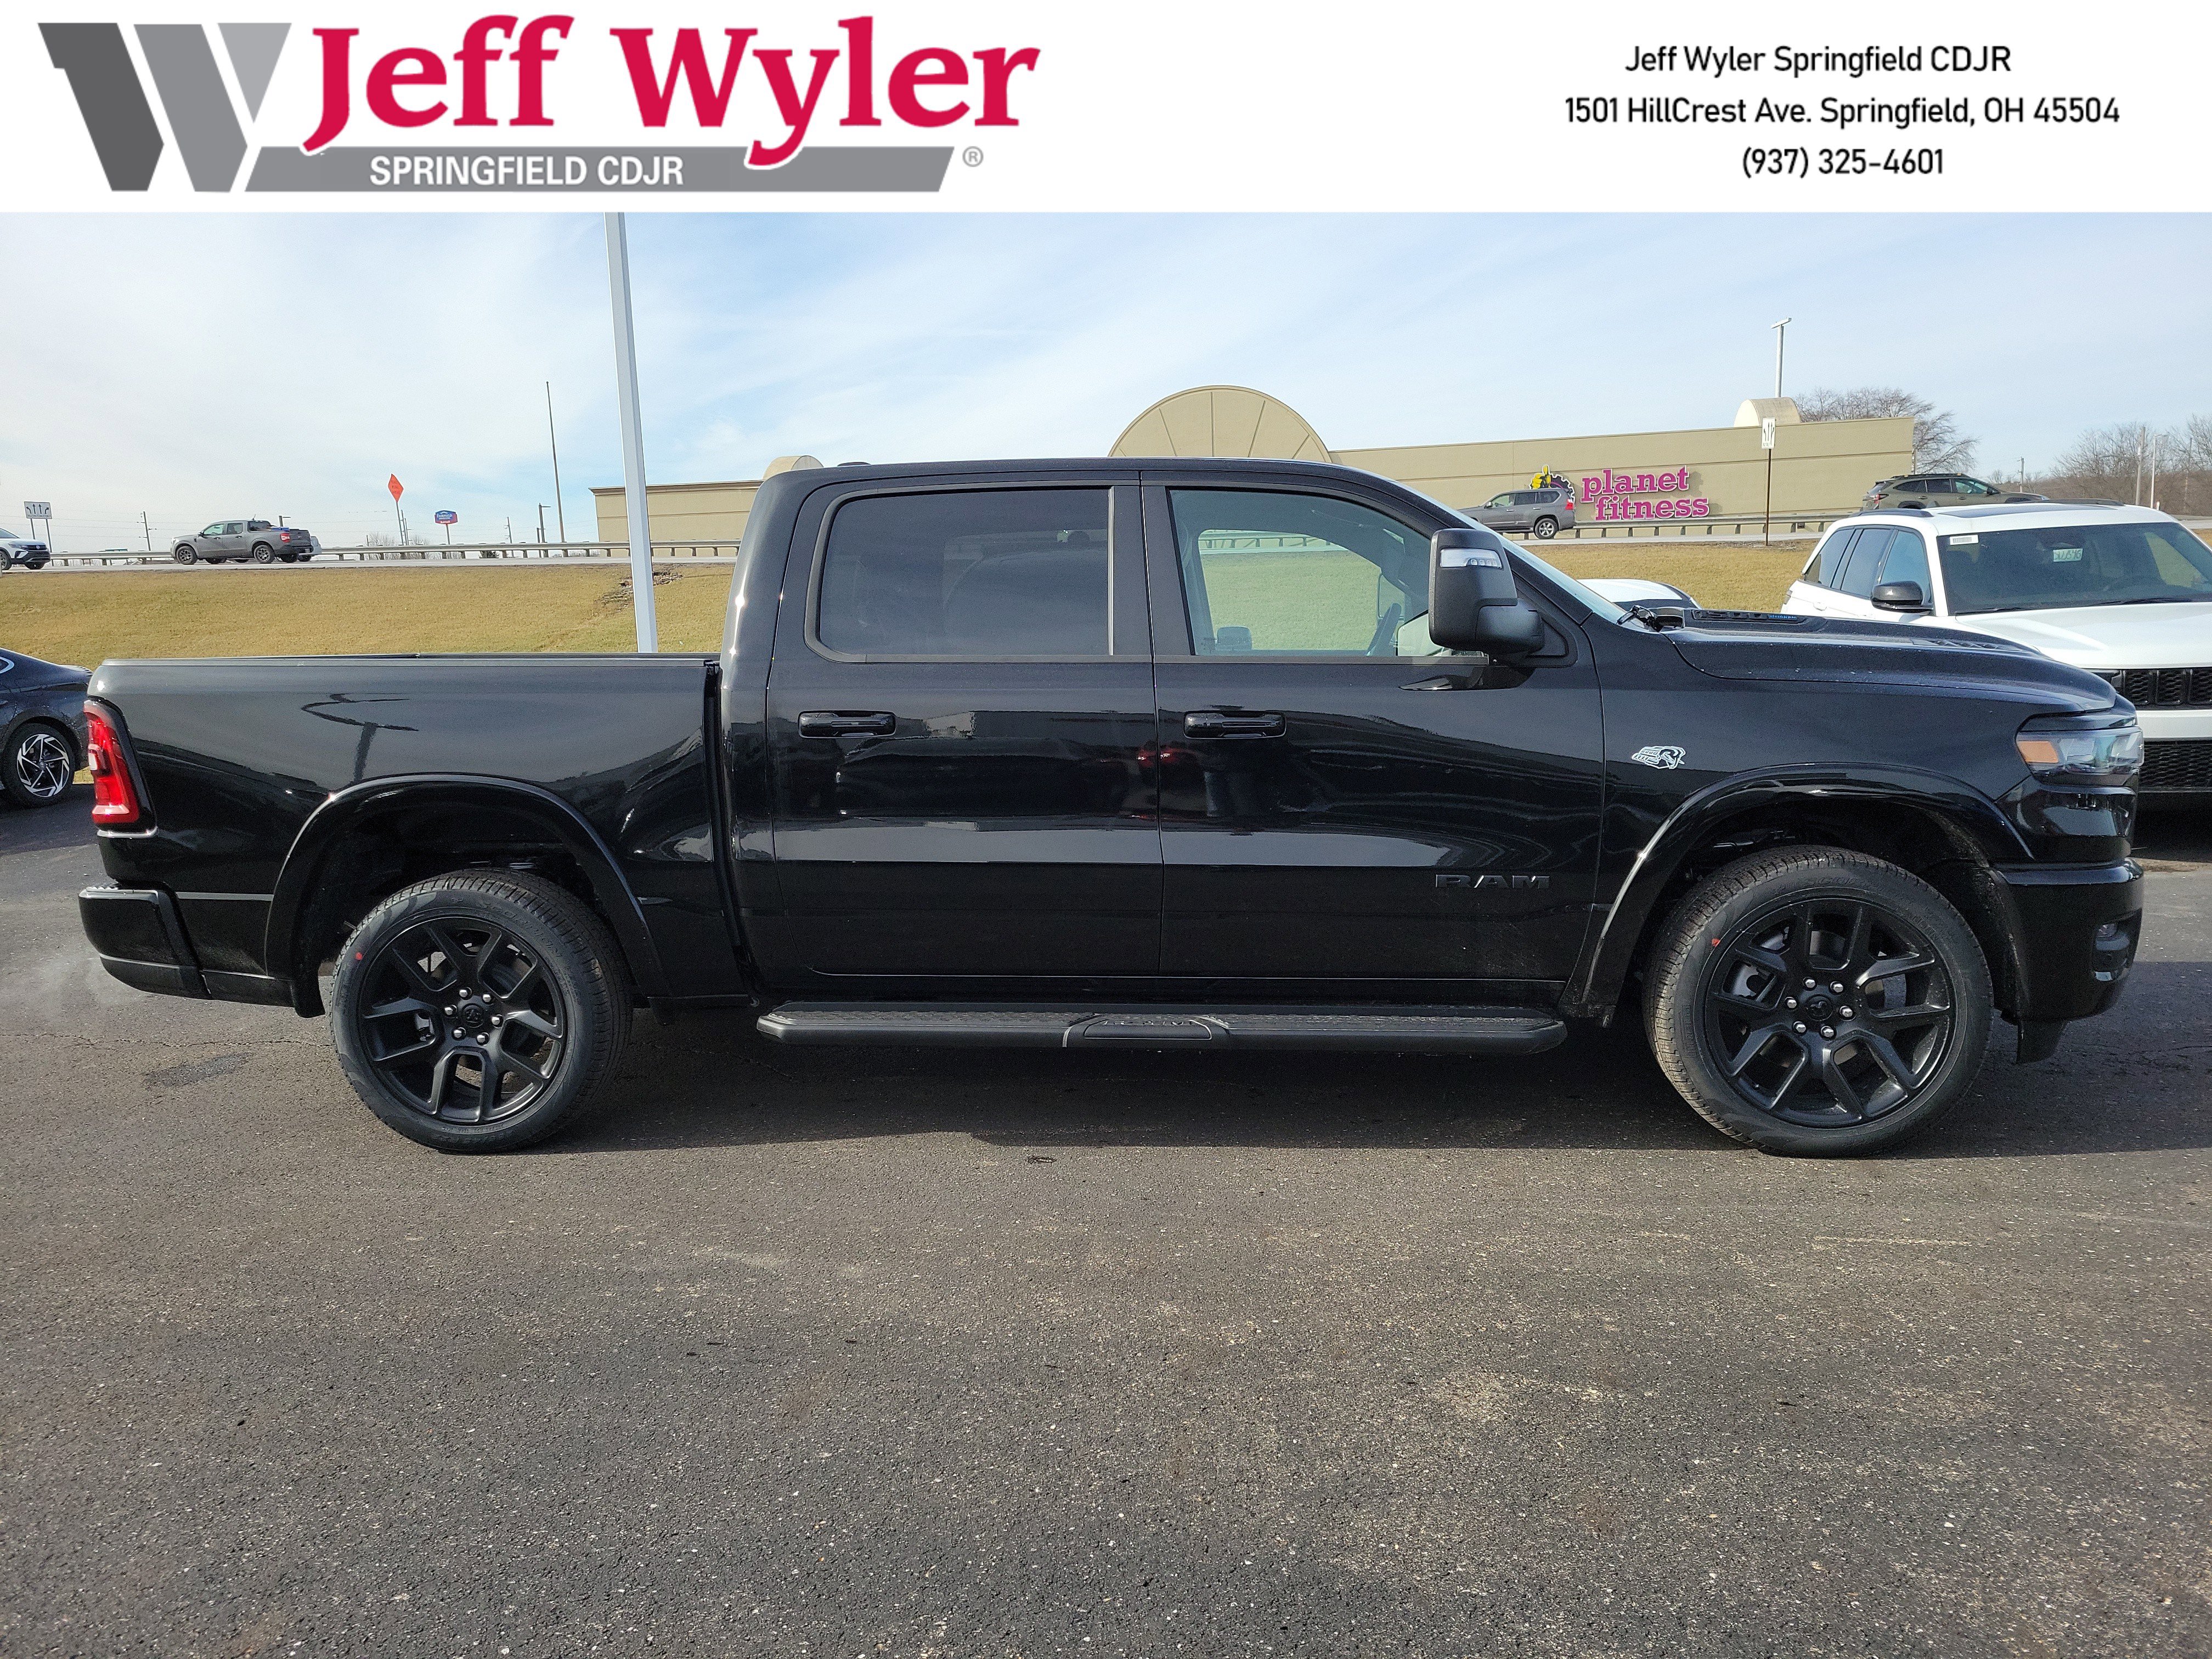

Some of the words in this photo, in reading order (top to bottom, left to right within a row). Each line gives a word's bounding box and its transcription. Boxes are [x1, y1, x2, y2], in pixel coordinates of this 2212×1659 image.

[1581, 466, 1690, 503] planet
[1595, 495, 1709, 521] fitness
[1435, 874, 1550, 889] RAM
